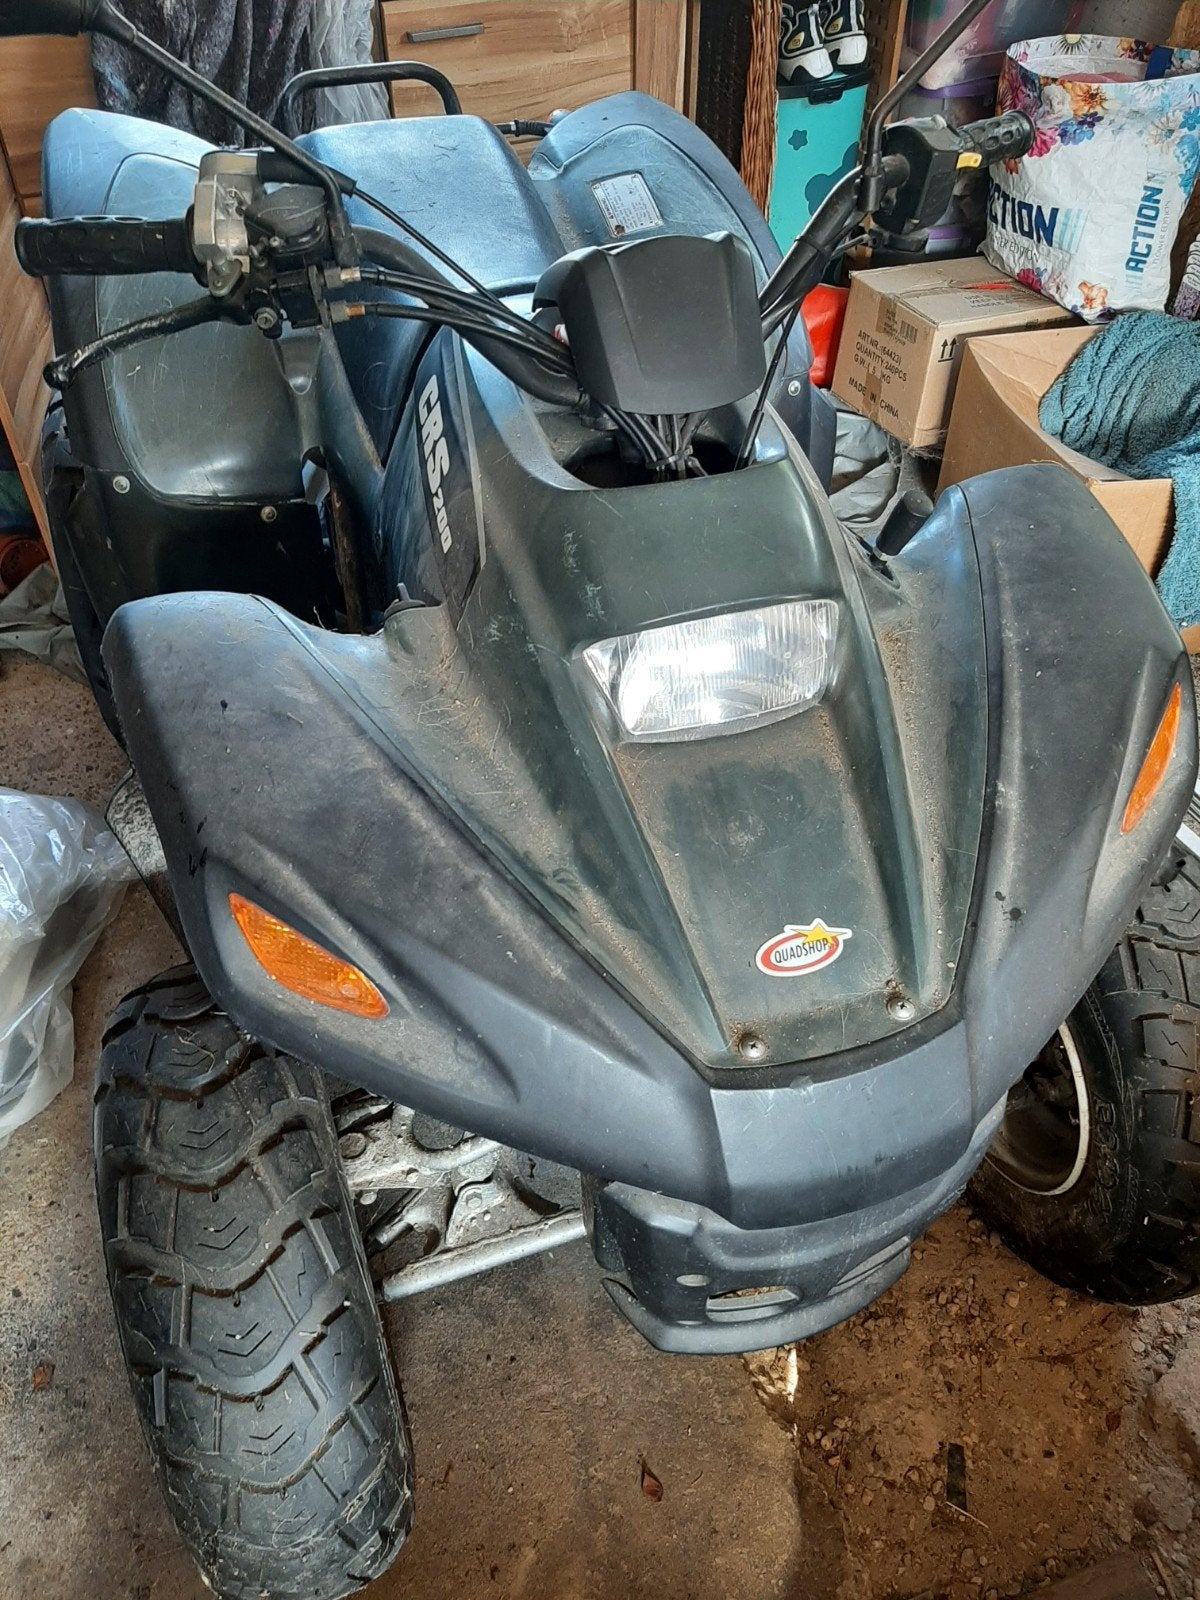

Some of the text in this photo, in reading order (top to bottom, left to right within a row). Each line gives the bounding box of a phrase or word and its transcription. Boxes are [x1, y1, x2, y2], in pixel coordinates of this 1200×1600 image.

[989, 183, 1060, 248] CTION
[1125, 185, 1164, 273] ACTION
[848, 376, 899, 420] MADE IN CHINA
[418, 374, 453, 554] CRS 200
[773, 937, 829, 964] QUADSHOP
